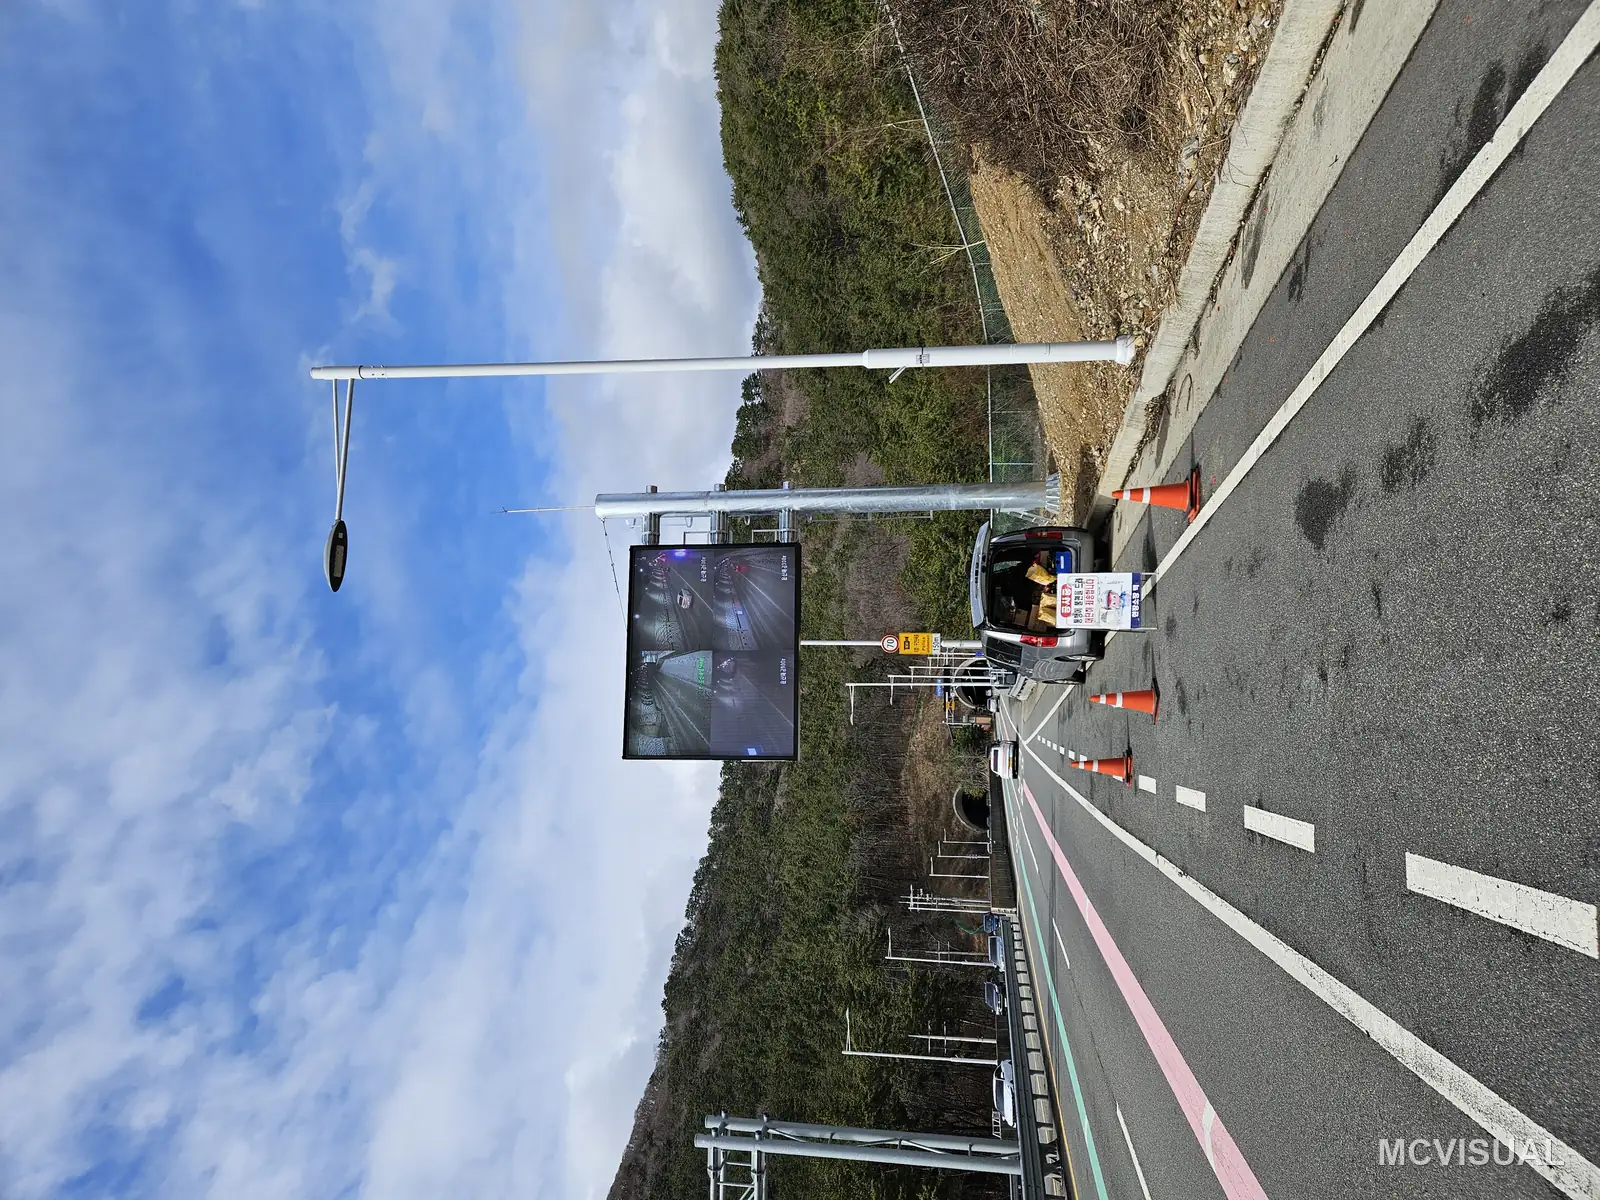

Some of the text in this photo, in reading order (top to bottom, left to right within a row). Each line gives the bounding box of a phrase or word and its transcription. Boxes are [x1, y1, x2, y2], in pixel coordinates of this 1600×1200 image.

[1073, 578, 1083, 623] 통행에 불편을 드려
[1085, 579, 1094, 623] 대단히 죄송합니다
[886, 639, 894, 648] 70
